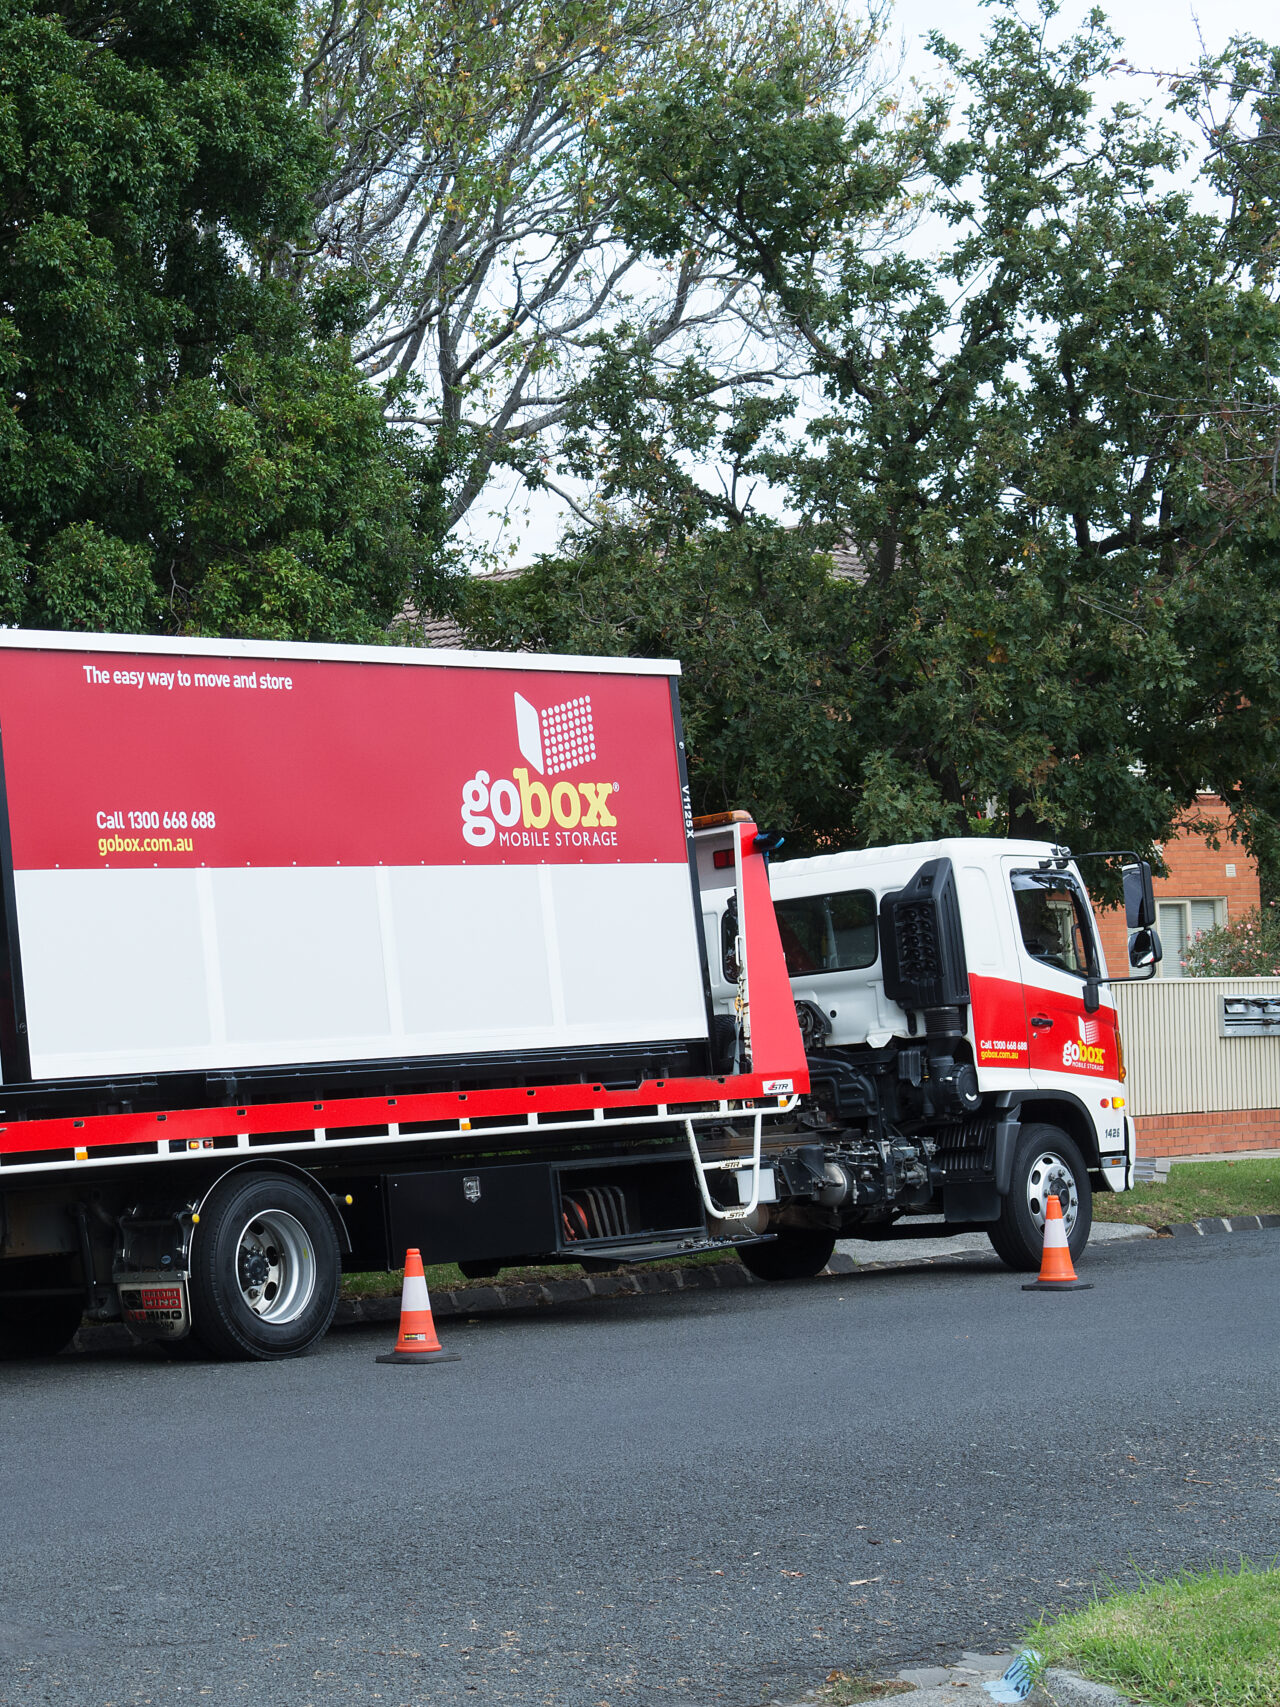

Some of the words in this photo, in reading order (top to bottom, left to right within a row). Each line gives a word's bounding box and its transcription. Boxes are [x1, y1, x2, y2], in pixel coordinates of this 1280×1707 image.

[83, 666, 110, 684] The
[113, 671, 144, 689] easy
[148, 673, 174, 690] way
[177, 670, 191, 686] to
[194, 673, 230, 687] move
[233, 672, 257, 688] and
[260, 673, 292, 690] store
[461, 767, 617, 847] gobox
[682, 784, 695, 839] V1125X
[96, 811, 125, 829] Call
[128, 811, 160, 829] 1300
[163, 811, 188, 829] 668
[191, 811, 216, 829] 688
[98, 834, 193, 856] gobox.com.au
[499, 831, 550, 846] MOBILE
[555, 831, 618, 846] STORAGE
[980, 1040, 992, 1049] Call
[993, 1040, 1006, 1050] 1300
[1007, 1041, 1016, 1050] 668
[1017, 1041, 1027, 1050] 688
[1063, 1040, 1104, 1066] gobox
[980, 1049, 1019, 1060] gobox.com.au
[722, 1161, 740, 1169] STR
[727, 1211, 745, 1219] STR
[145, 1298, 179, 1307] HINO
